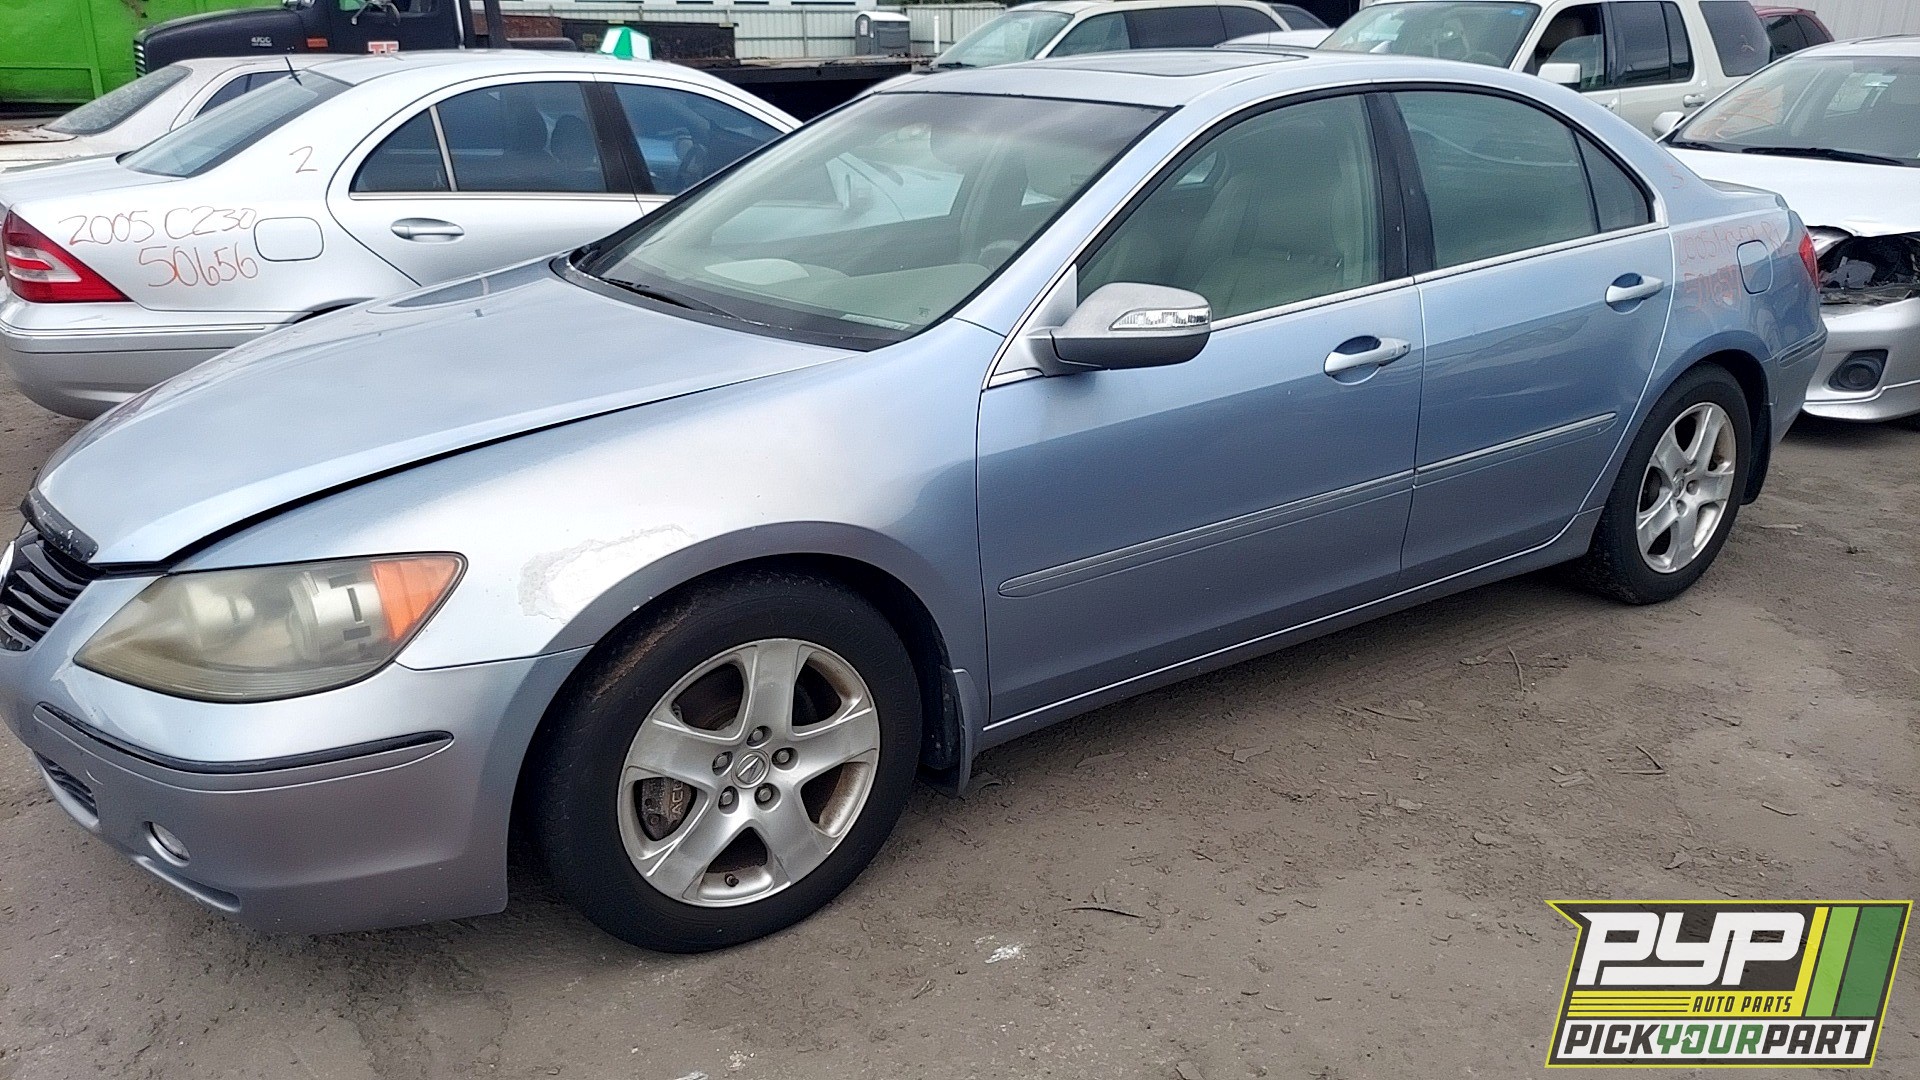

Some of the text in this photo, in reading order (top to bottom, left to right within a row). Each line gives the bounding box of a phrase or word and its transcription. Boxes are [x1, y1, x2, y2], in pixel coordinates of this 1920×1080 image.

[289, 145, 318, 174] 2
[58, 205, 257, 246] 2005 C230
[138, 241, 259, 287] 50656
